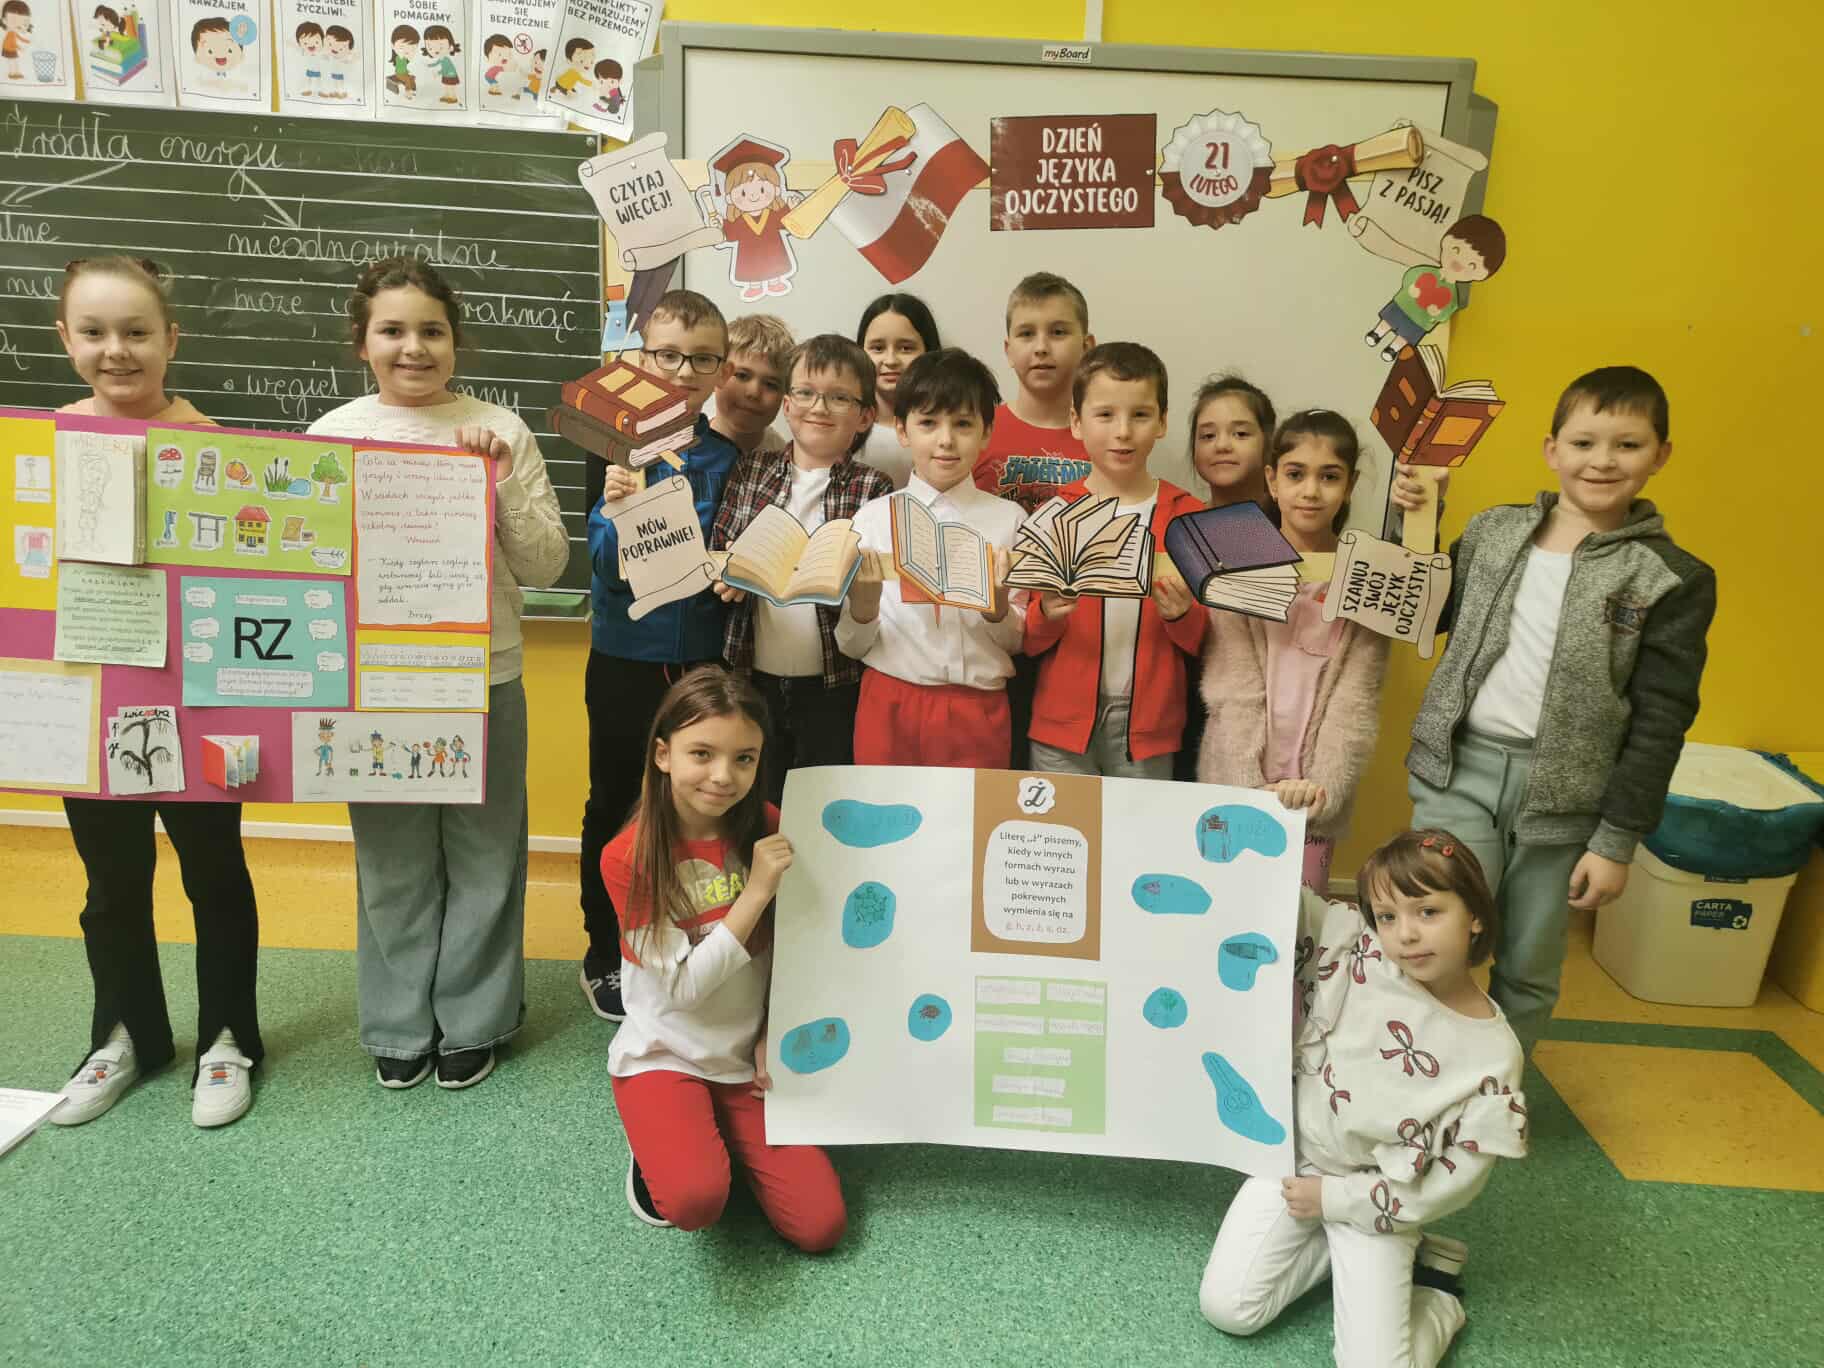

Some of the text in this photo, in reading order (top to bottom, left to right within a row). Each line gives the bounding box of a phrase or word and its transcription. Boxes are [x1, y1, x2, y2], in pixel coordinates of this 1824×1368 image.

[567, 6, 586, 21] BEZ
[1044, 47, 1090, 60] myBoard
[1042, 122, 1102, 153] DZIEŃ
[1205, 142, 1230, 169] 21
[1036, 157, 1117, 187] JĘZYKA
[1189, 173, 1239, 197] LUTEGO
[1408, 167, 1444, 194] PISZ
[609, 170, 665, 204] CZYTAJ
[1379, 178, 1395, 198] Z
[616, 190, 673, 225] WIĘCEJ!
[1004, 187, 1139, 214] OJCZYSTEGO
[636, 516, 668, 539] MÓW
[622, 525, 697, 562] POPRAWNIE!
[1343, 561, 1370, 613] SZANUJ
[1363, 571, 1387, 610] SWÓJ
[1381, 572, 1407, 617] JĘZYK
[1395, 561, 1430, 635] OJCZYSTY!
[234, 616, 294, 660] RZ
[1024, 781, 1047, 807] Ż
[1000, 831, 1026, 843] Literę
[1044, 835, 1082, 848] piszemy,
[1008, 846, 1032, 857] kiedy
[1043, 849, 1073, 860] innych
[1005, 860, 1076, 874] formach wyrazu
[1005, 877, 1073, 890] lub w wyrazach
[1011, 891, 1067, 905] pokrewnych
[1696, 902, 1732, 911] CARTA
[1003, 905, 1073, 919] wymienia się na
